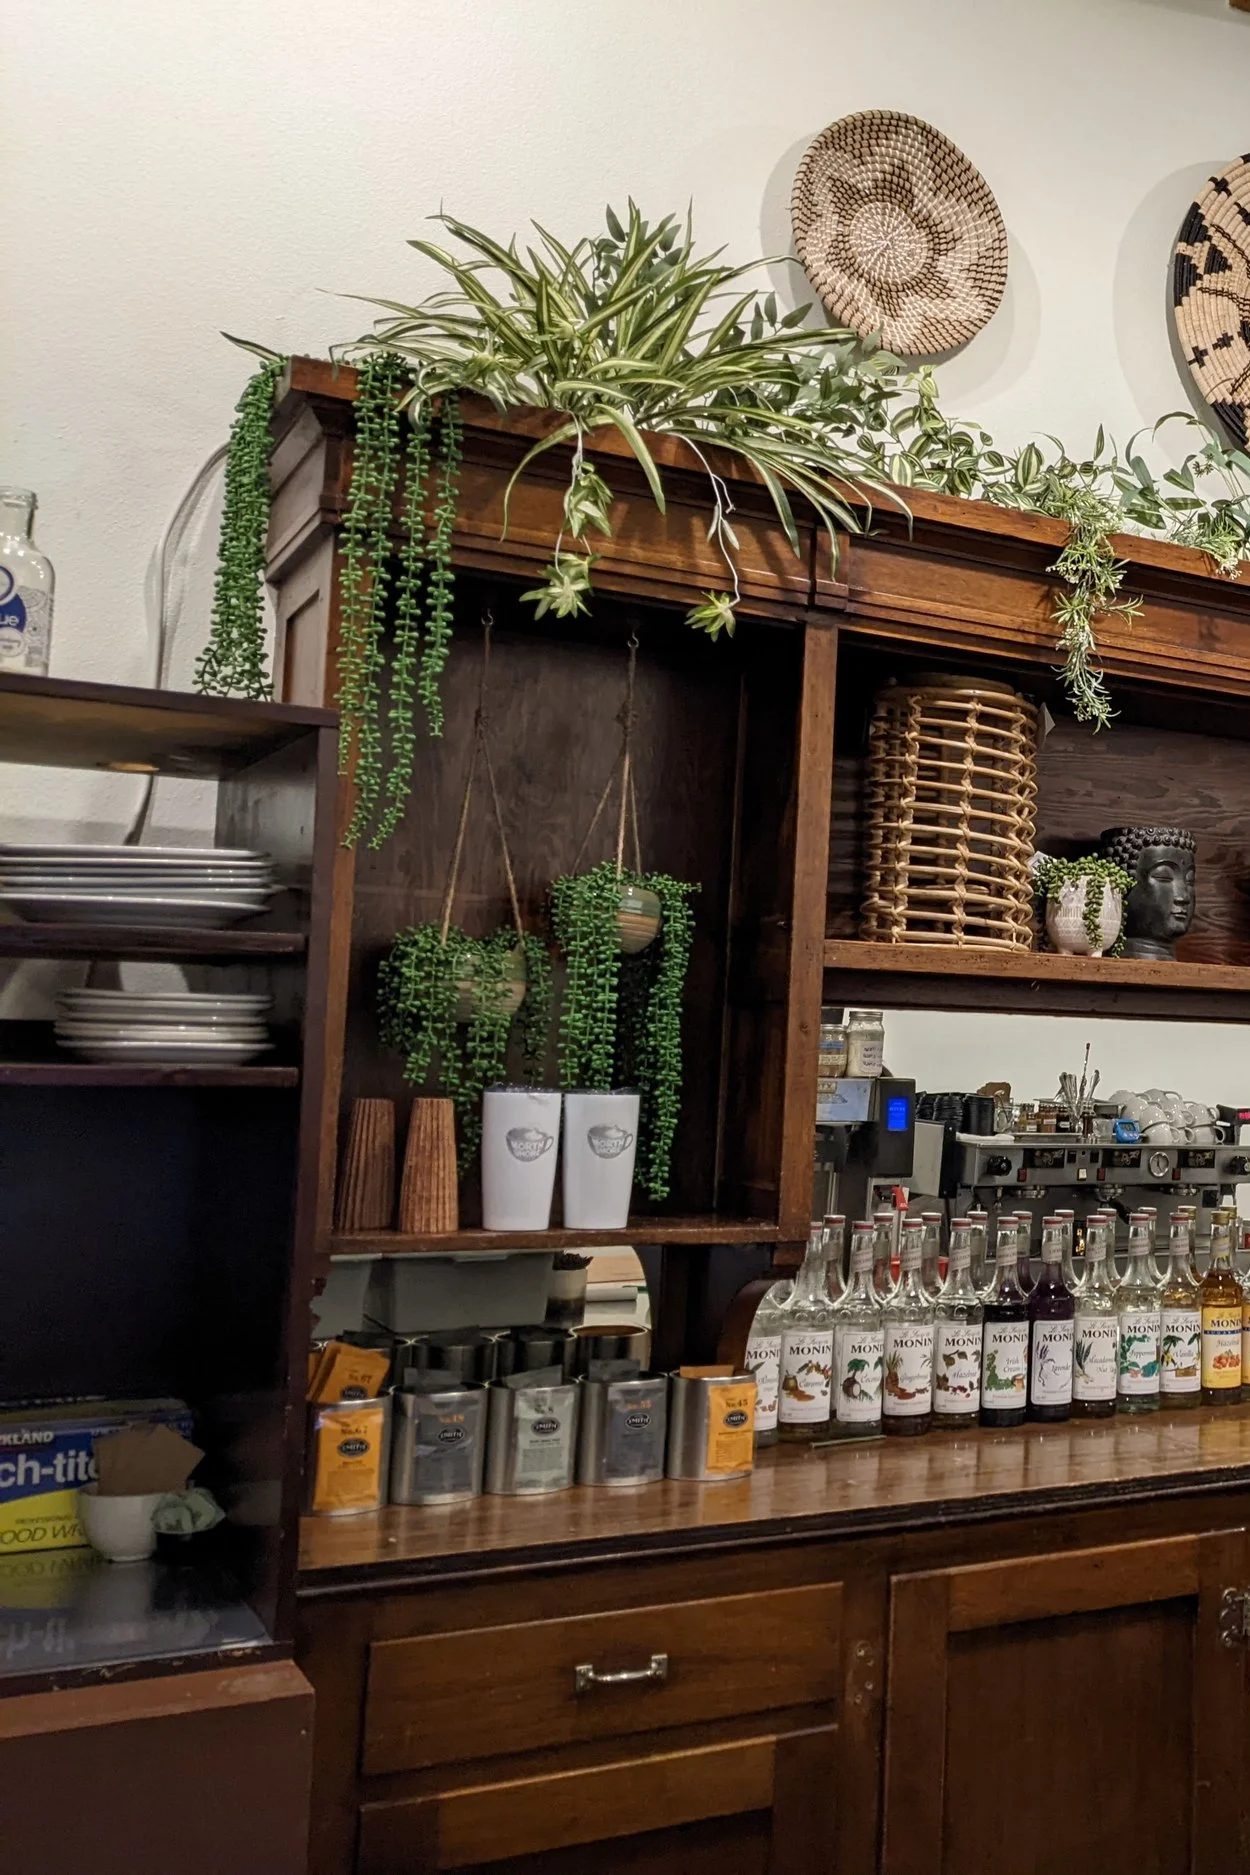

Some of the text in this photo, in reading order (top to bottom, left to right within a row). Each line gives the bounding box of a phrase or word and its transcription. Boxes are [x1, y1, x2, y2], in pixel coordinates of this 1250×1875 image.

[1082, 1328, 1117, 1338] MONIN
[1127, 1324, 1160, 1334] MONIN
[1165, 1323, 1200, 1333] MONIN
[945, 1337, 982, 1347] MONIN
[1042, 1332, 1072, 1342] MONI
[893, 1338, 932, 1348] MONIN
[789, 1345, 832, 1355] MONIN
[850, 1344, 882, 1354] MONI
[746, 1349, 779, 1360] MONI
